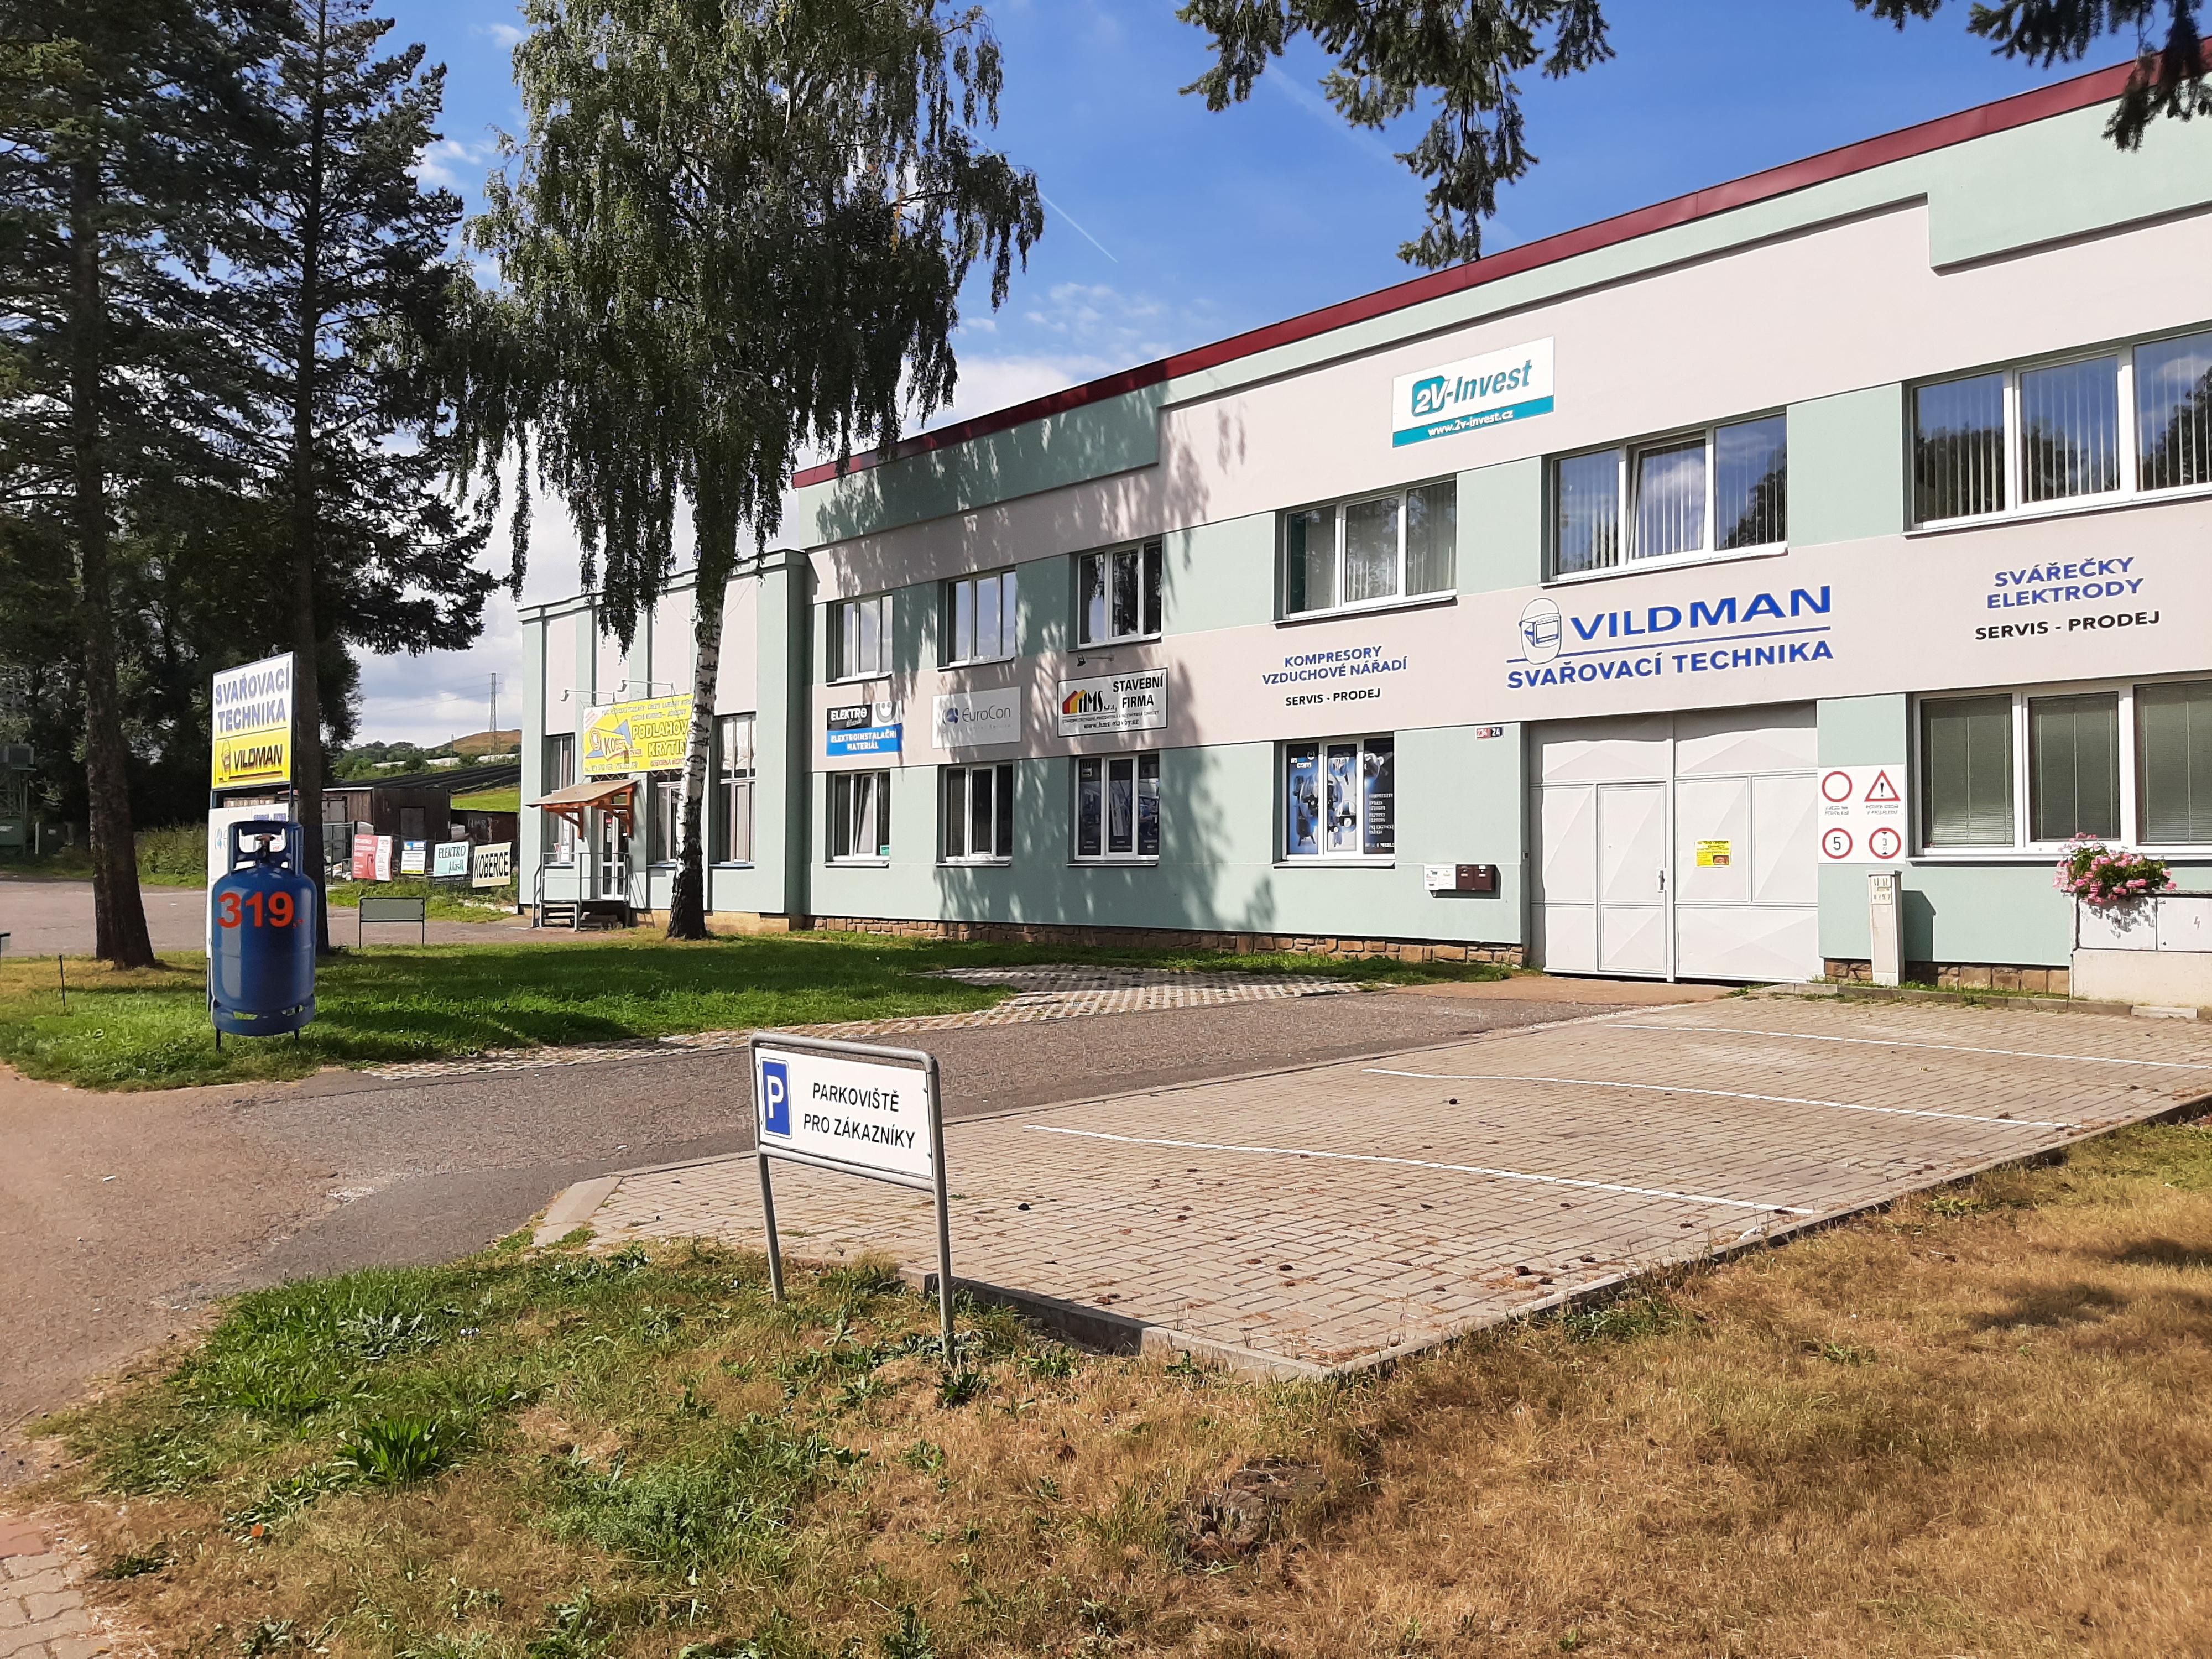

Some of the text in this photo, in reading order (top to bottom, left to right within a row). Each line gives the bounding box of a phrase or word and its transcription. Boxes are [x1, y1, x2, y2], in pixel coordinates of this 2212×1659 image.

[1413, 359, 1532, 414] 2V-Invest
[1427, 409, 1514, 436] www.2v-invest.cz
[1994, 556, 2135, 587] SVÁŘEČKY
[1987, 578, 2144, 609] ELEKTRODY
[1570, 585, 1831, 640] VILDMAN
[1974, 621, 2049, 640] SERVIS
[2068, 611, 2160, 632] PRODEJ
[1262, 656, 1407, 684] VZDUCHOVÉ NÁŘADÍ
[1285, 646, 1381, 667] KOMPRESORY
[1506, 640, 1833, 690] SVAŘOVACÍ TECHNIKA
[215, 661, 289, 706] SVAŘOVACÍ
[1113, 673, 1164, 692] STAVEBNÍ
[1122, 695, 1154, 708] FIRMA
[1286, 694, 1323, 706] SERVIS
[1333, 688, 1380, 701] PRODEJ
[218, 698, 286, 733] TECHNIKA
[831, 708, 868, 721] ELEKTRO
[962, 705, 1011, 722] EuroCon
[632, 719, 690, 740] PODLAHOV
[831, 729, 896, 743] ELEKTROINSTALAČNÍ
[233, 743, 283, 773] VILDMAN
[648, 740, 687, 757] KRYTIN
[847, 741, 879, 751] MATERIÁL
[439, 845, 466, 859] ELEKTRO
[1833, 836, 1841, 851] 5
[474, 852, 509, 879] KOBERCE
[766, 1074, 784, 1119] P
[813, 1082, 899, 1112] PARKOVIŠTĚ
[804, 1113, 916, 1149] PRO ZÁKAZNÍKY
